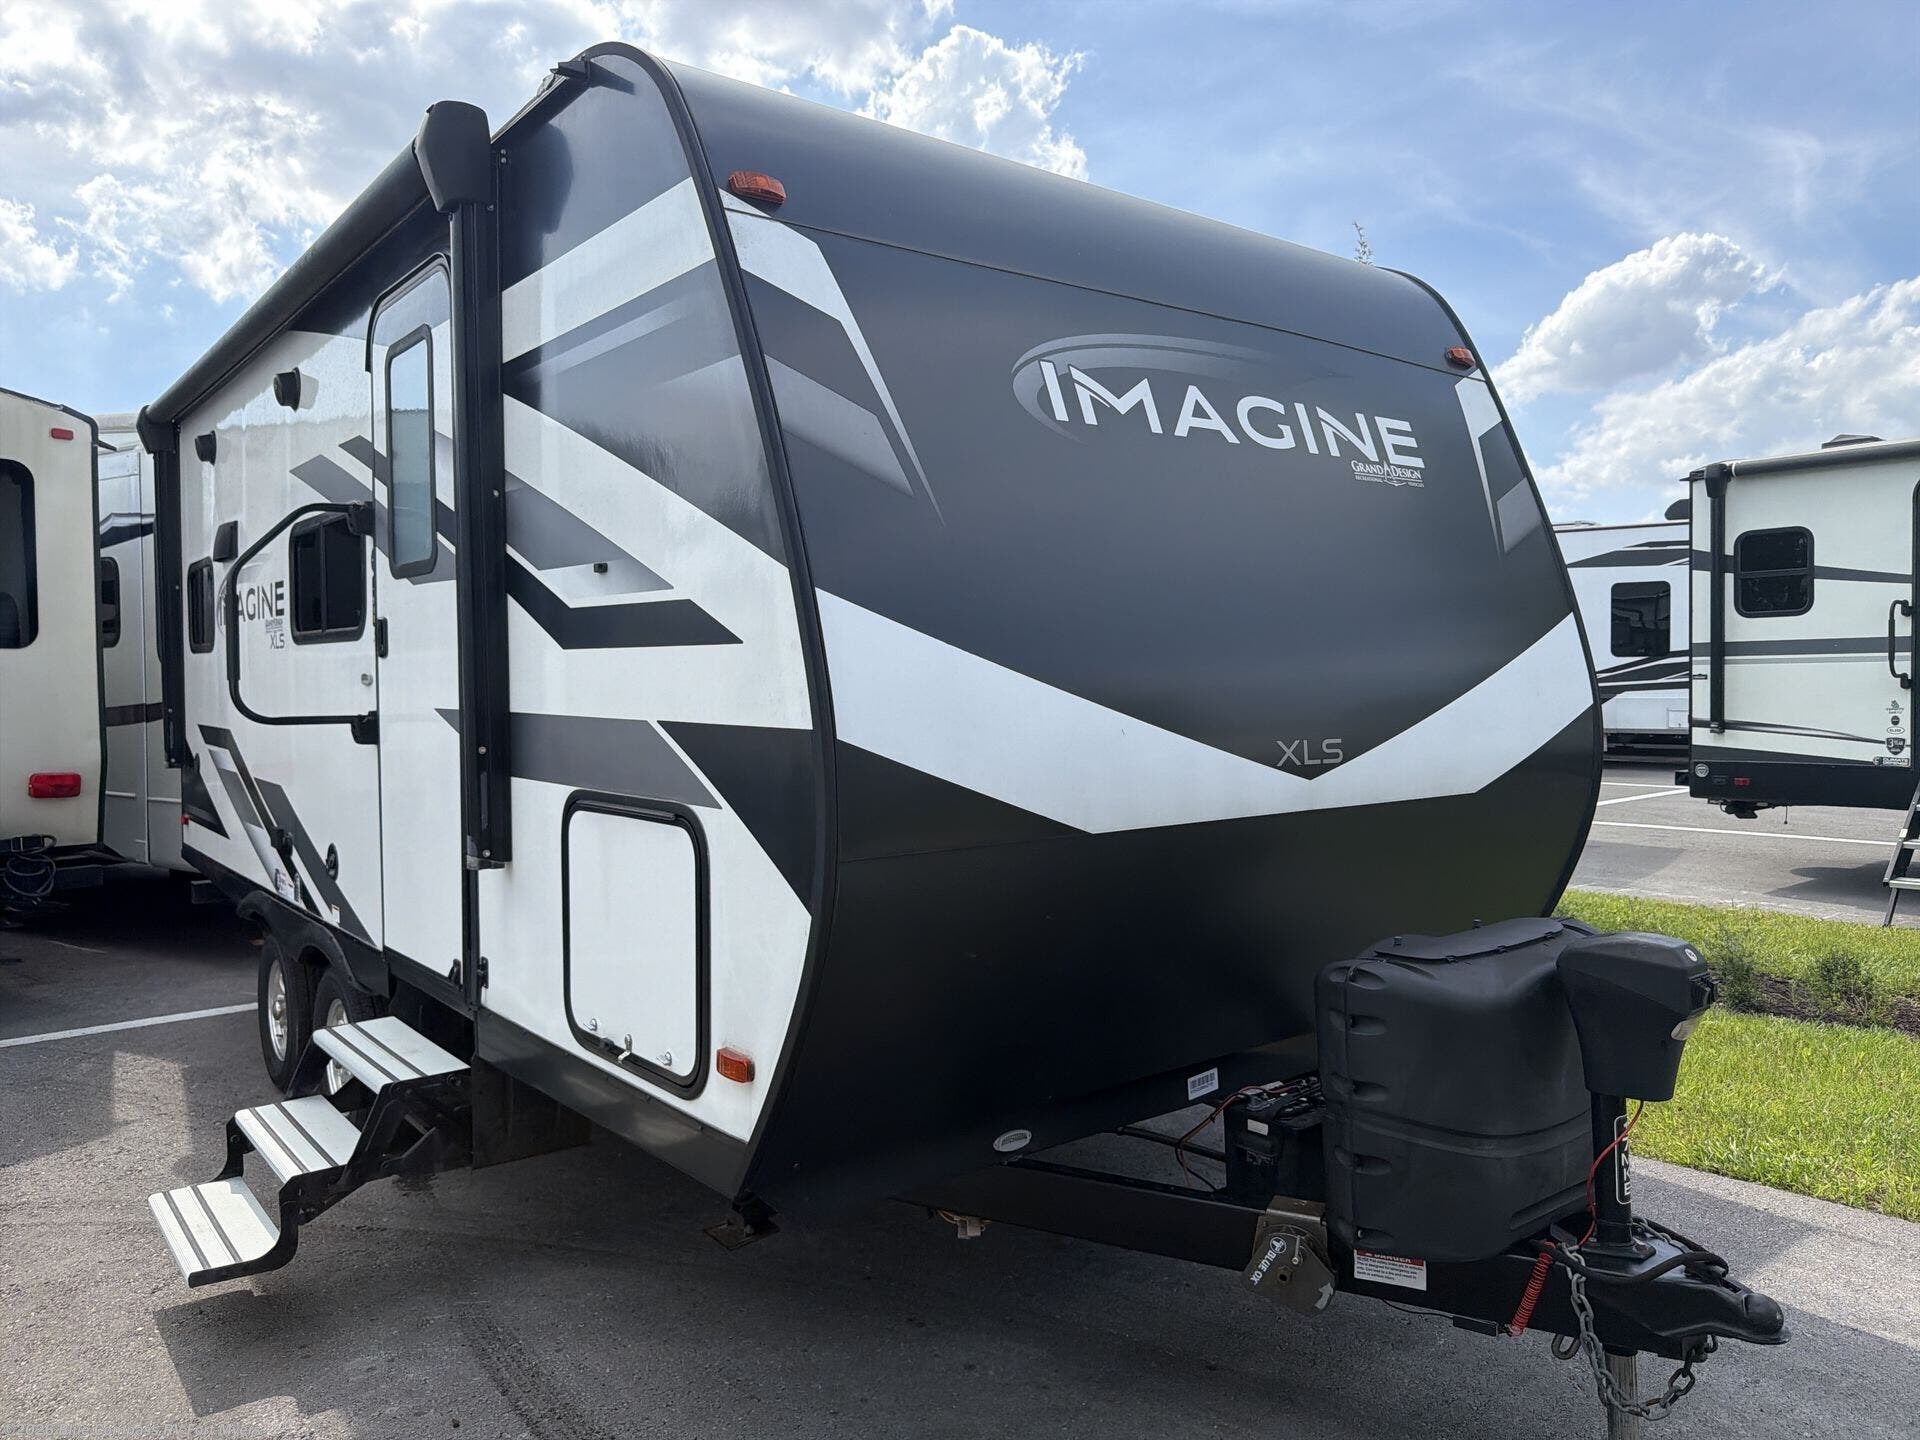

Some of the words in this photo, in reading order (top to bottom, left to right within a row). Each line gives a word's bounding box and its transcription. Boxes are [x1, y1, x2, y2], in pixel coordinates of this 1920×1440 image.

[1038, 360, 1426, 469] IMAGINE
[1351, 460, 1384, 475] GRAND
[1389, 465, 1422, 480] DESIGN
[219, 580, 285, 627] IAGINE
[270, 633, 285, 649] XLS
[1276, 738, 1344, 767] XLS
[1258, 1250, 1277, 1272] BLUE
[1250, 1270, 1263, 1286] OX
